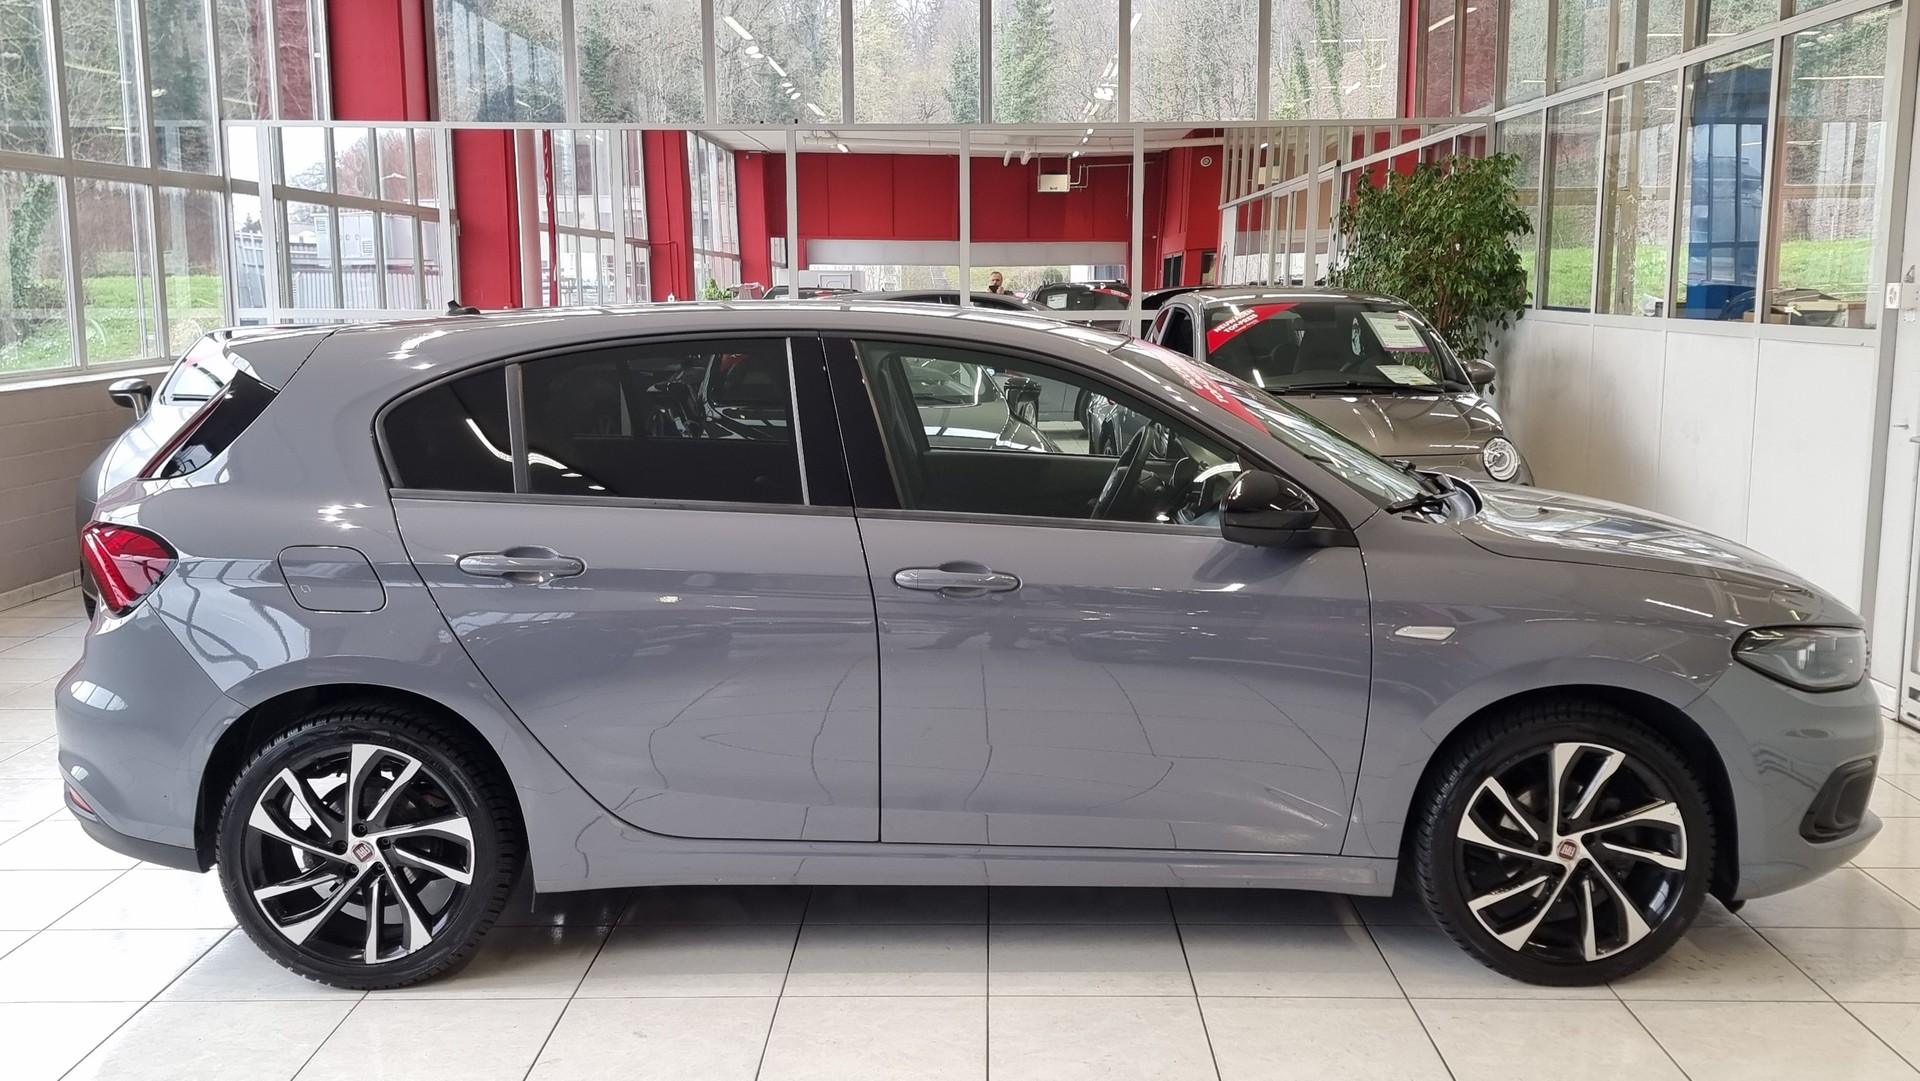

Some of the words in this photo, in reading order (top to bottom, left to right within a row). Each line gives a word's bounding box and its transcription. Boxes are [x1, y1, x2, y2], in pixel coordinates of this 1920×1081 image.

[1213, 308, 1255, 333] NEUWAGEN
[355, 845, 371, 861] FIAT
[1559, 843, 1577, 858] FIAT
